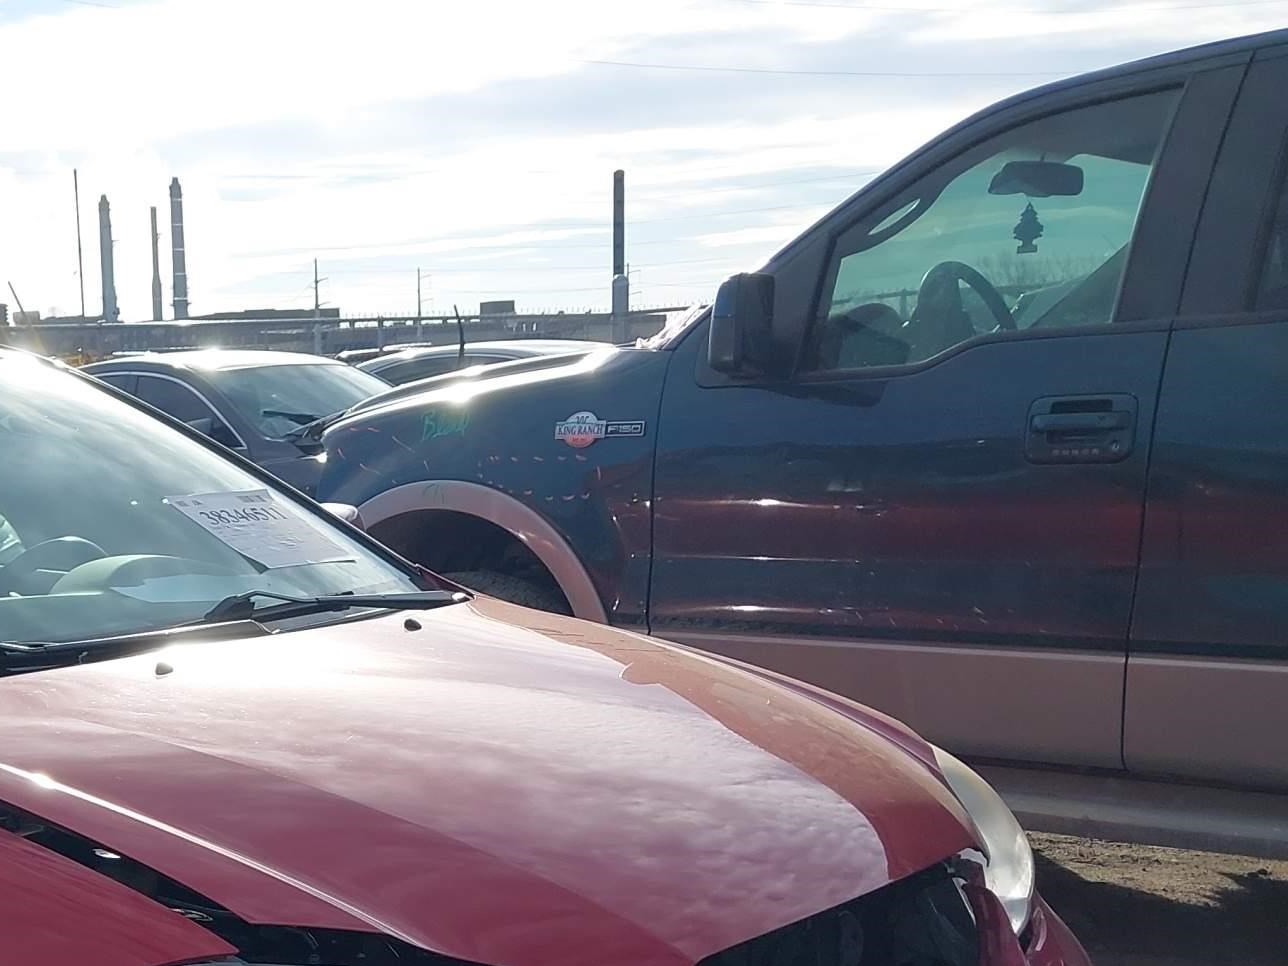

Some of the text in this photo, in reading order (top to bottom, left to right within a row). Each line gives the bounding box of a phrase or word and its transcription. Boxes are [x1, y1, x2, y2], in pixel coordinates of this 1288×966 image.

[557, 423, 604, 436] KING RANCH
[199, 506, 288, 525] 38346511
